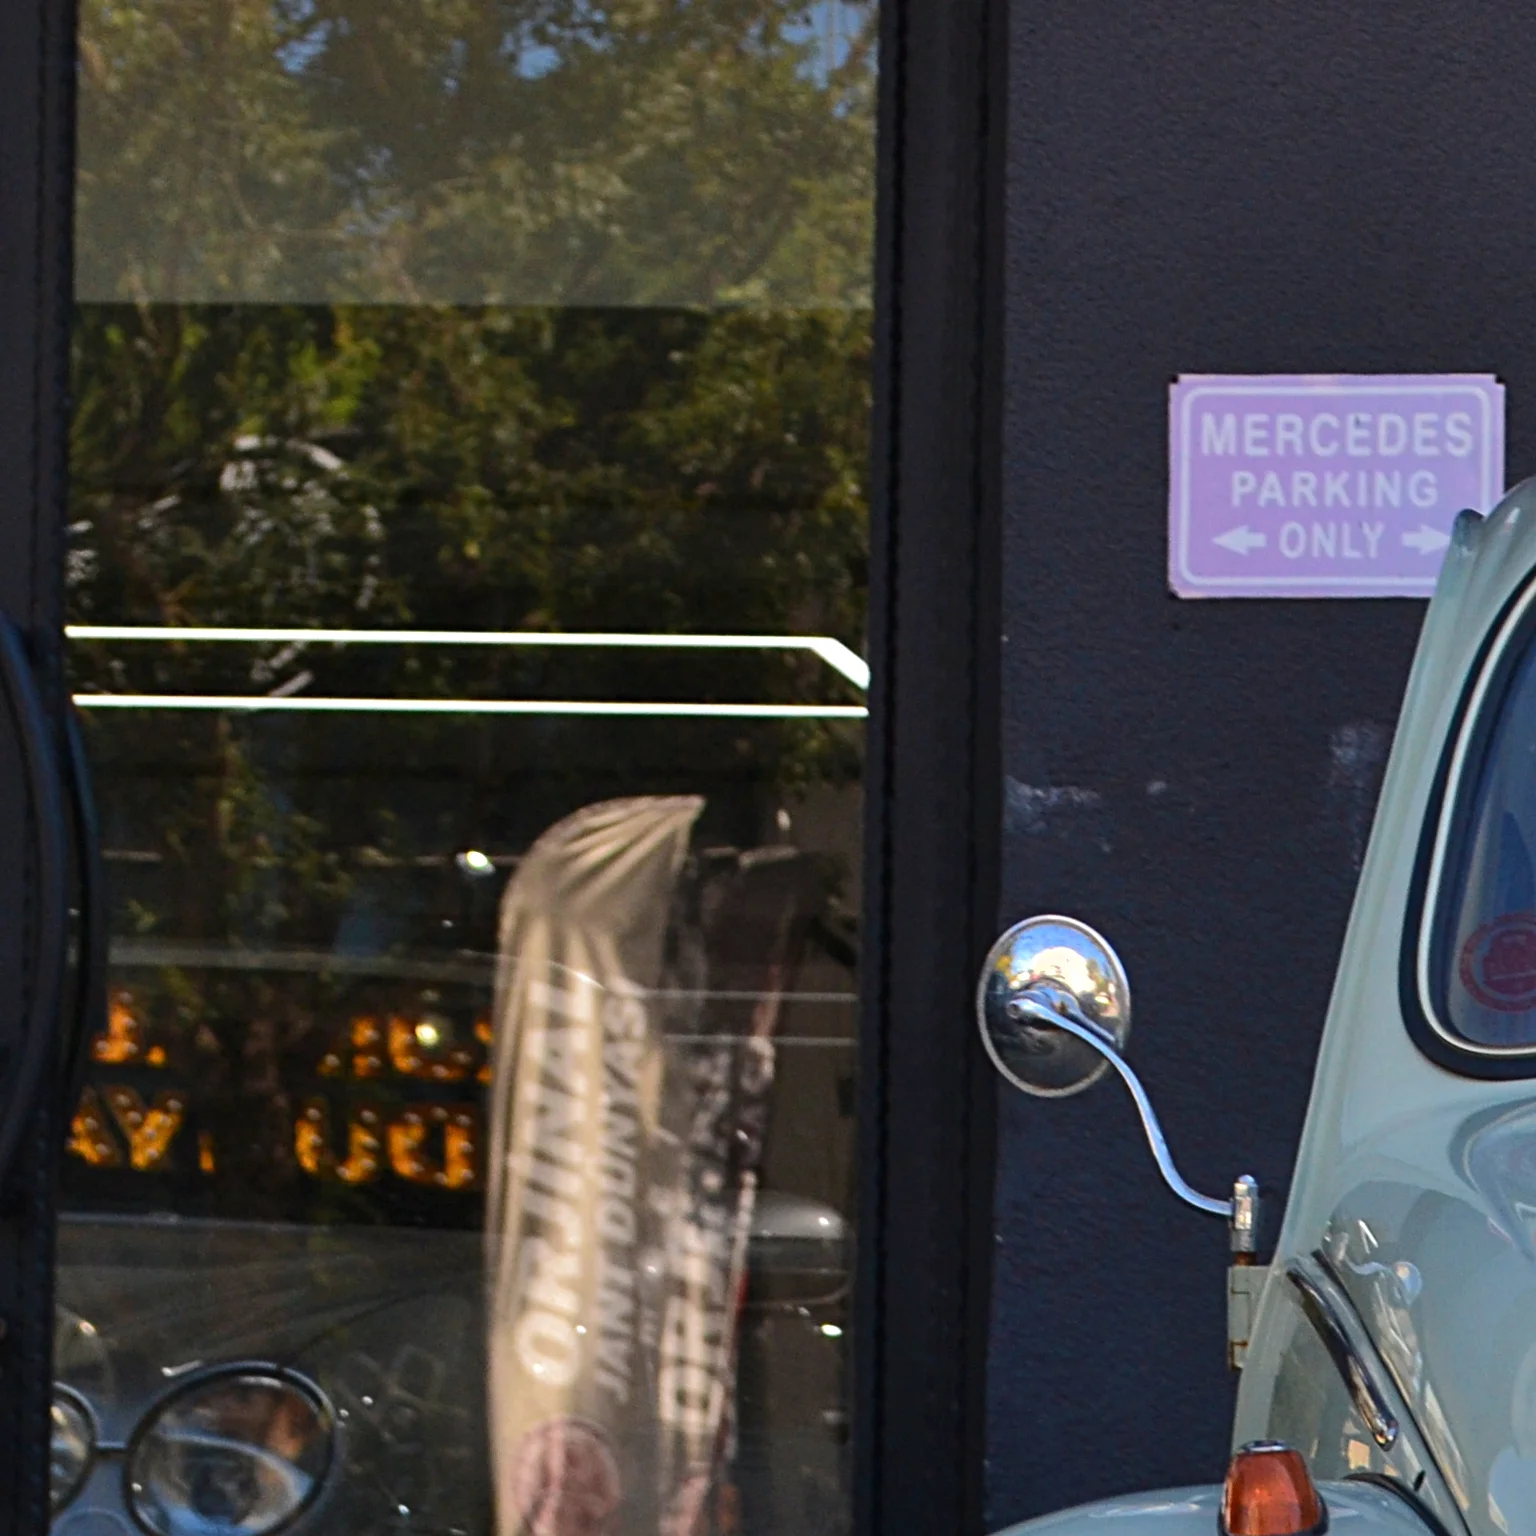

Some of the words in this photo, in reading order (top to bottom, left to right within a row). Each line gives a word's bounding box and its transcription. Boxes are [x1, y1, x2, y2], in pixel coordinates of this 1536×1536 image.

[1201, 412, 1475, 458] MERCEDES
[1231, 470, 1439, 509] PARKING
[1278, 520, 1386, 560] ONLY
